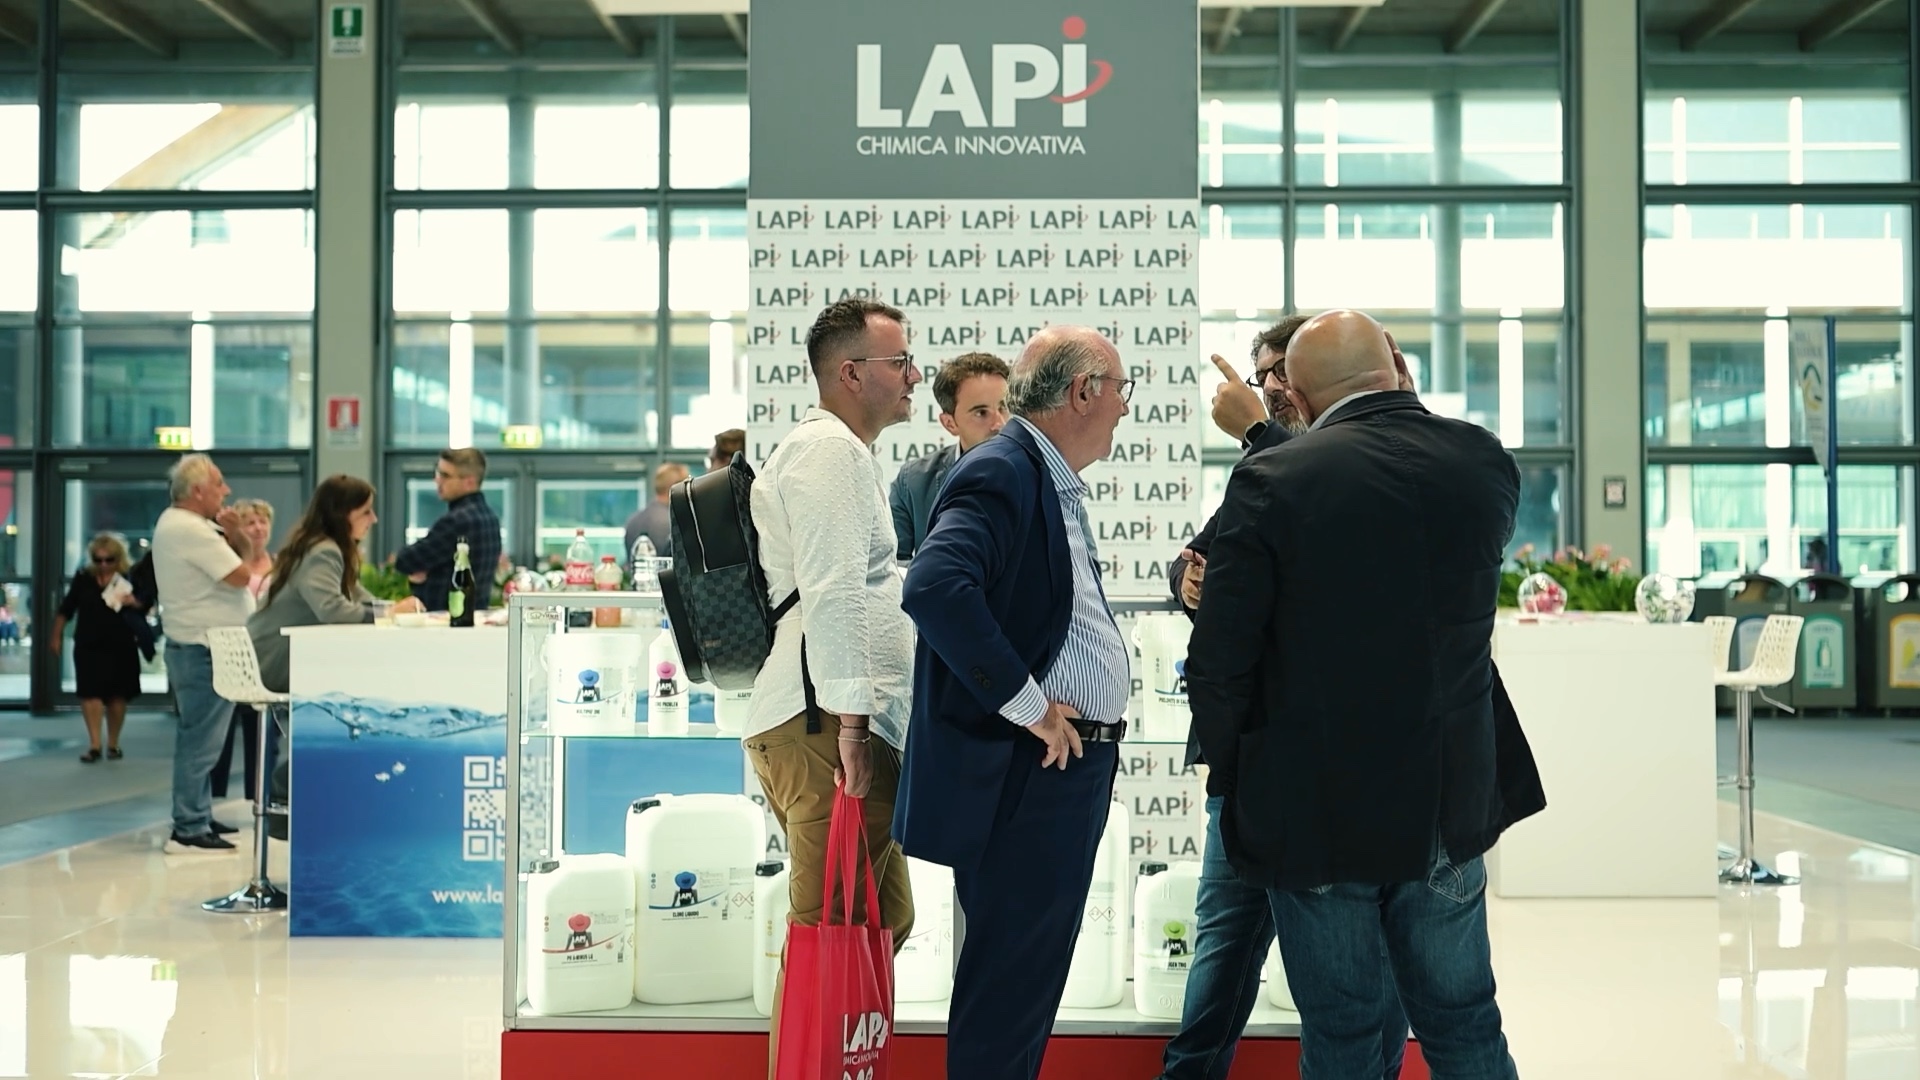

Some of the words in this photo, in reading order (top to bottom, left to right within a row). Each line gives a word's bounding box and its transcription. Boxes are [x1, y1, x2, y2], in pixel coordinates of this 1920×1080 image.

[857, 135, 948, 155] CHIMICA
[955, 135, 1086, 155] INNOVATIVA
[432, 884, 503, 904] www.la
